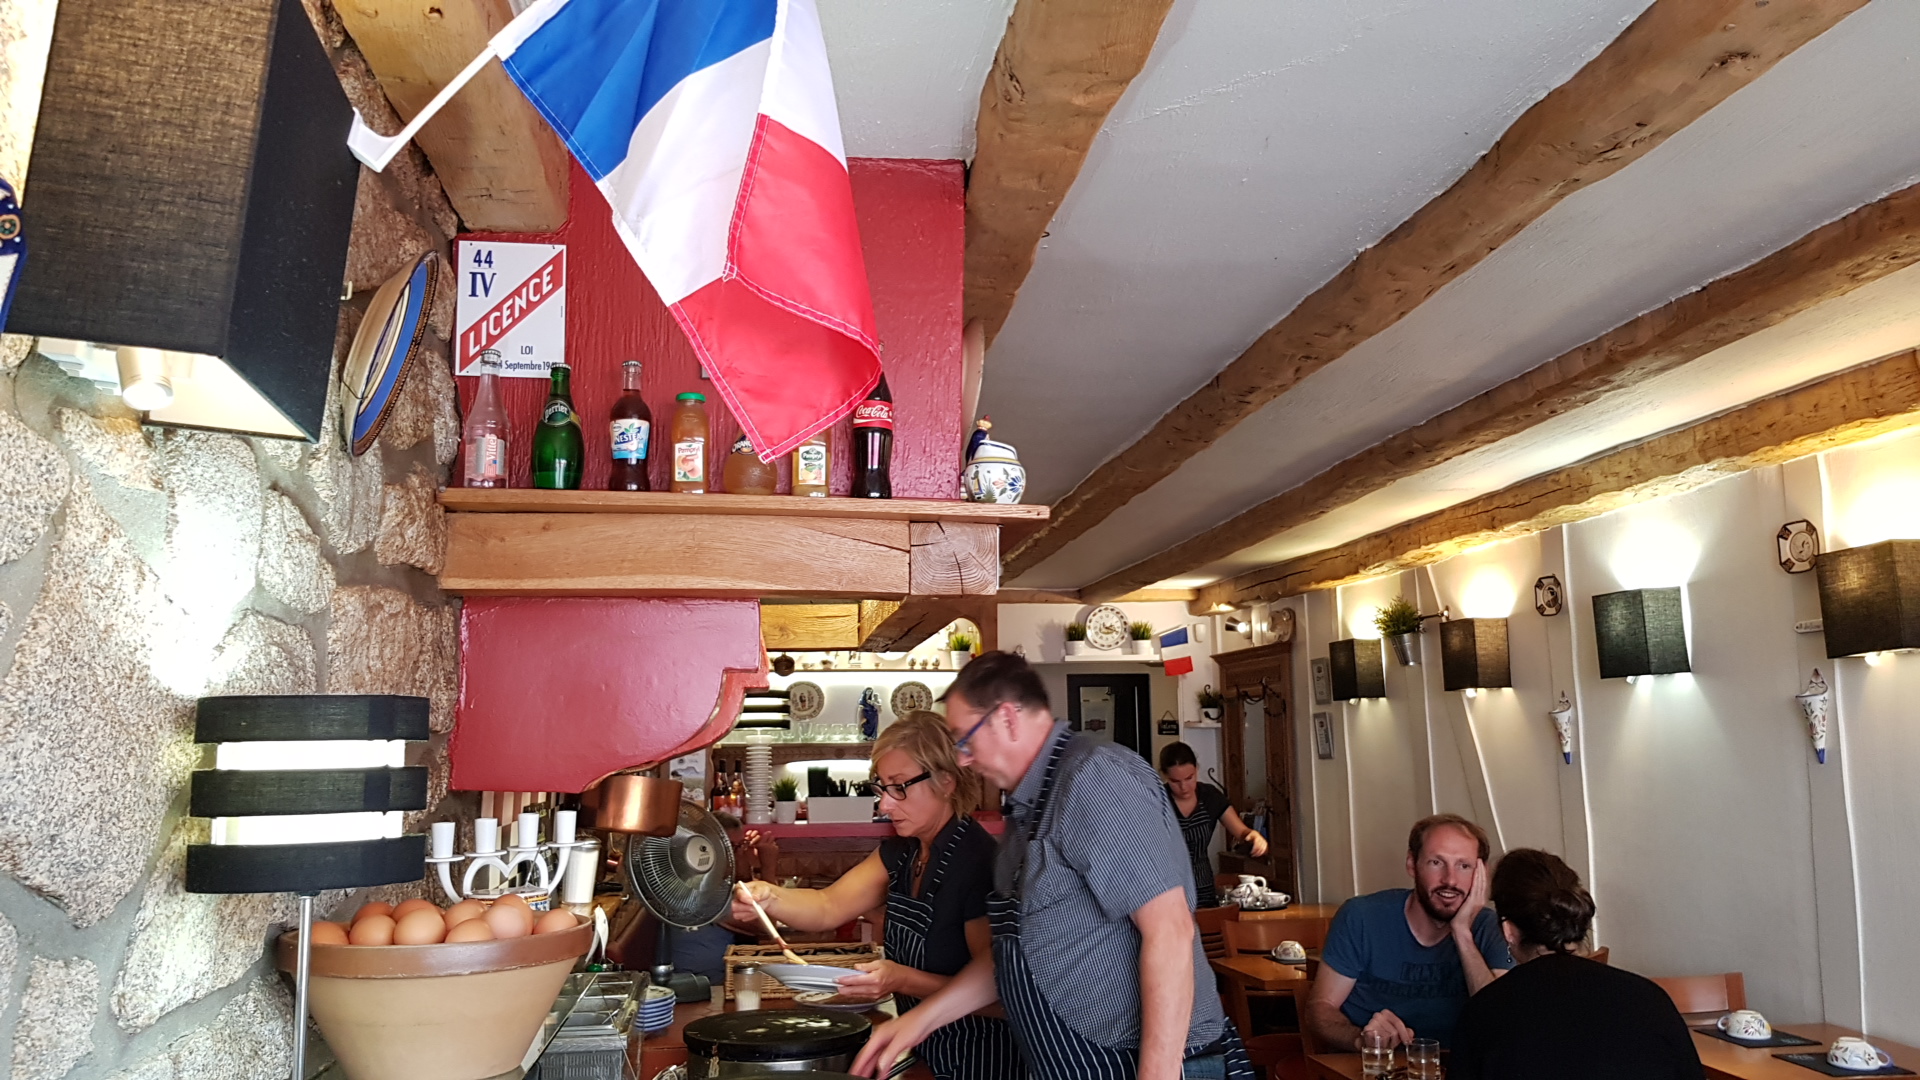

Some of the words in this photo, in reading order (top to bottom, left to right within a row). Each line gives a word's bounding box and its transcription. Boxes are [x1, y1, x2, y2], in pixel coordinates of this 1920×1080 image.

[473, 249, 494, 268] 44
[468, 271, 497, 298] IV
[469, 264, 554, 358] LICENCE
[520, 345, 534, 355] LOI
[505, 360, 542, 371] Septembre
[544, 402, 568, 423] Perrier
[614, 433, 643, 444] NESTEA
